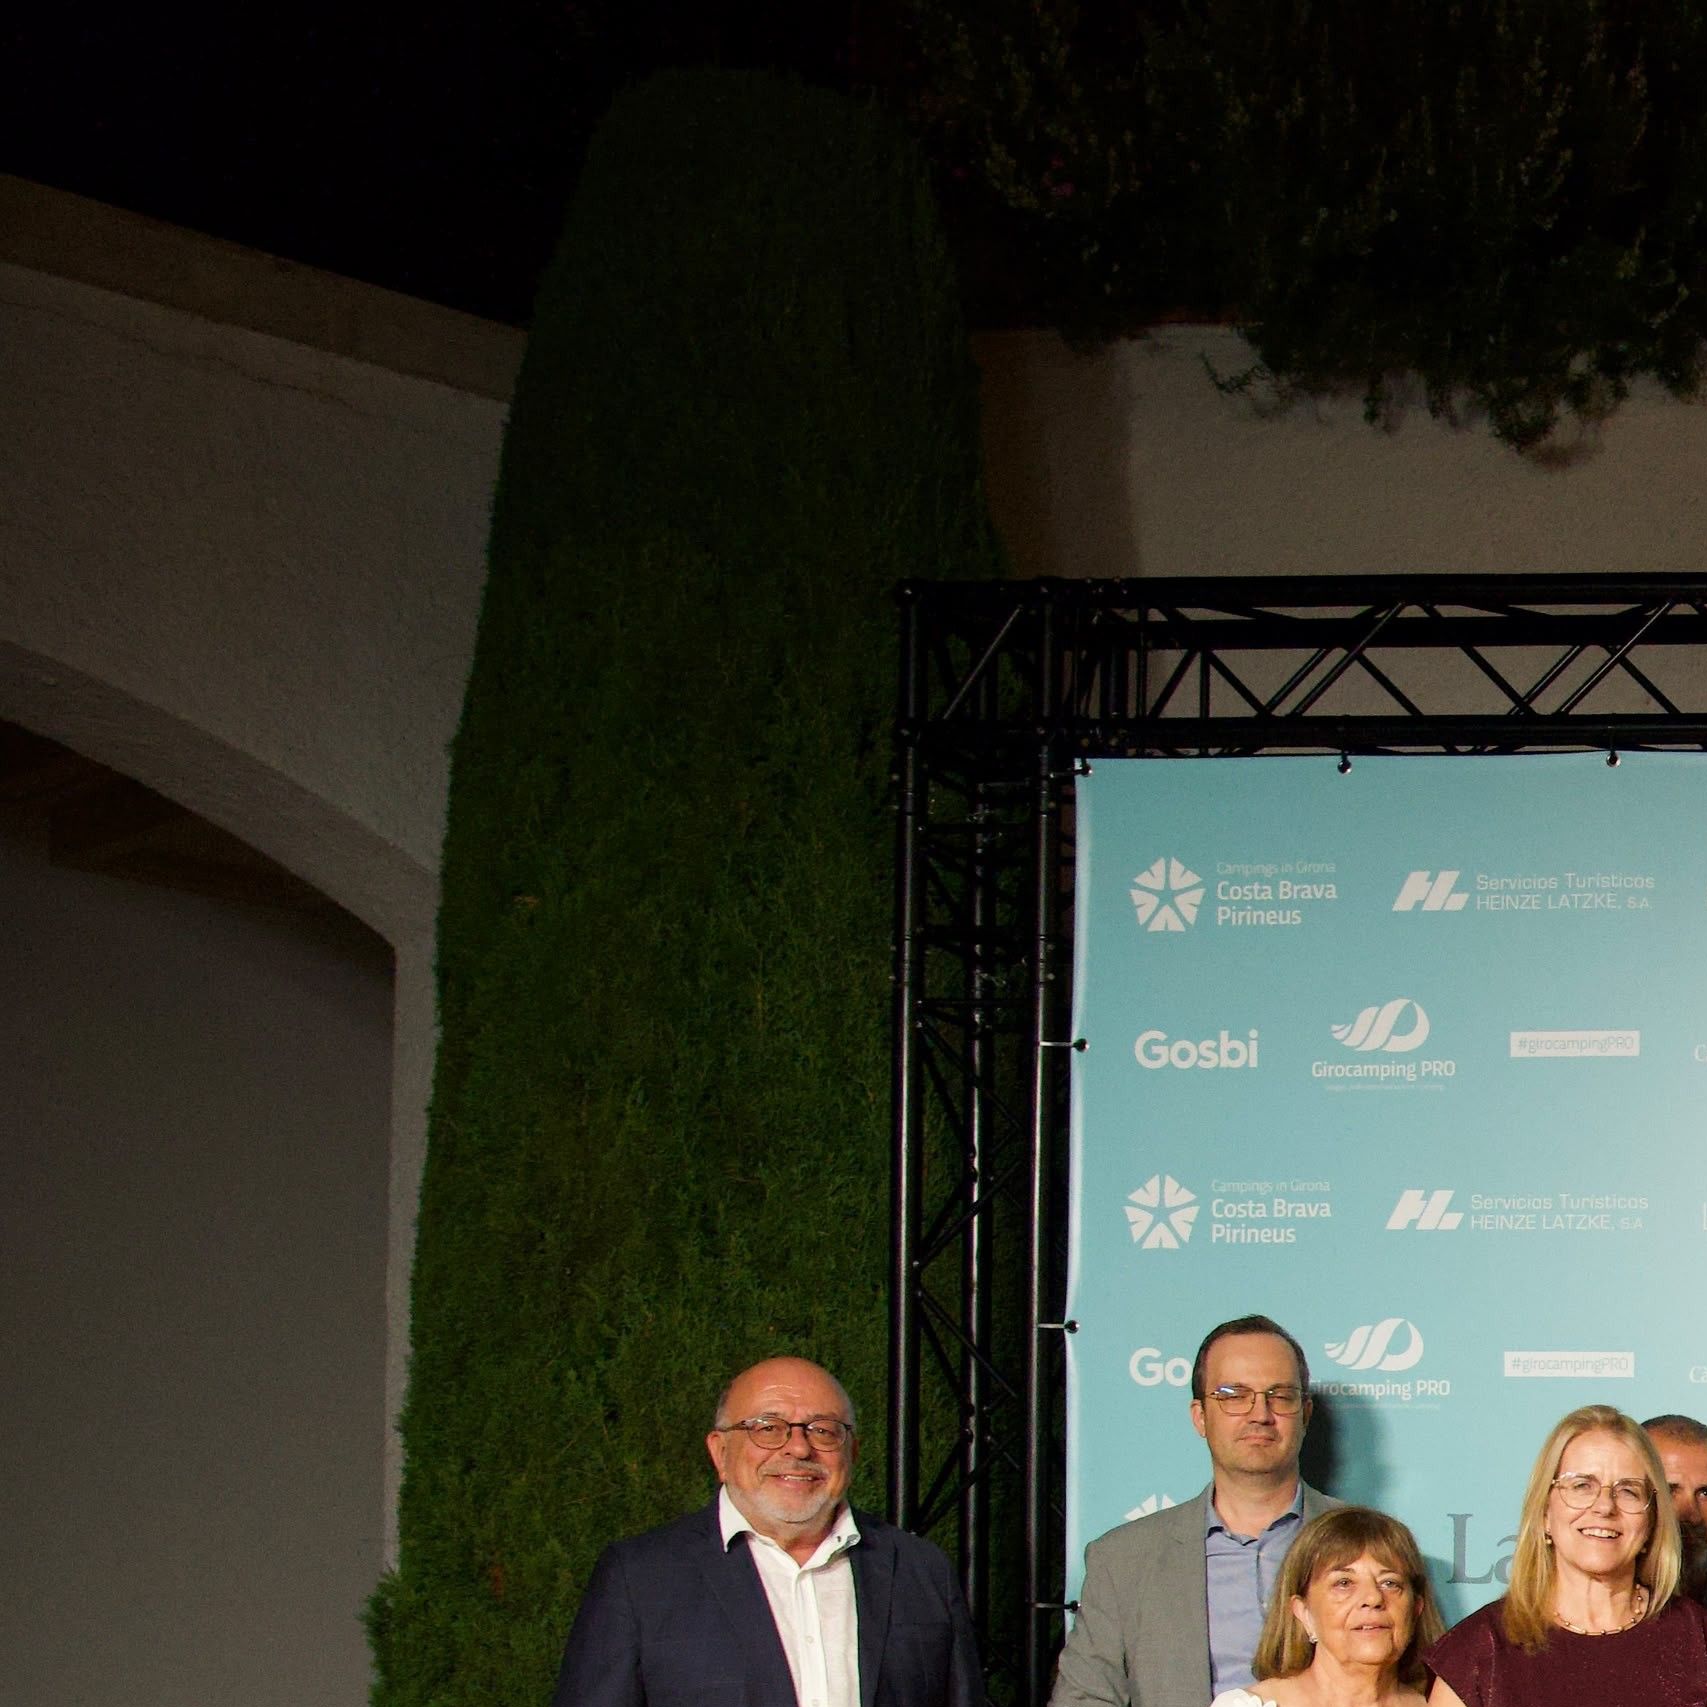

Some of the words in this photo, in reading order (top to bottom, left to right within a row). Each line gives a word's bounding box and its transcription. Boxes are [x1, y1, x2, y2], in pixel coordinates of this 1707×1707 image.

[1217, 861, 1278, 876] Campings
[1282, 861, 1293, 874] in
[1295, 860, 1336, 874] Girona
[1477, 873, 1559, 890] Servicios
[1565, 872, 1656, 889] Turísticos
[1217, 881, 1273, 900] Costa
[1279, 881, 1337, 900] Brava
[1477, 895, 1542, 911] HEINZE
[1217, 905, 1302, 926] Pirineus
[1134, 1028, 1258, 1070] Gosbi
[1518, 1034, 1634, 1054] #girocampingPRO
[1312, 1060, 1416, 1081] Girocamping
[1421, 1060, 1456, 1078] PRO
[1211, 1179, 1273, 1195] Campings
[1276, 1179, 1287, 1192] in
[1290, 1178, 1330, 1192] Girona
[1211, 1199, 1268, 1219] Costa
[1273, 1199, 1332, 1219] Brava
[1471, 1194, 1553, 1210] Servicios
[1471, 1214, 1536, 1231] HEINZE
[1211, 1223, 1296, 1244] Pirineus
[1512, 1356, 1629, 1374] #girocampingPRO
[1416, 1379, 1451, 1396] PRO
